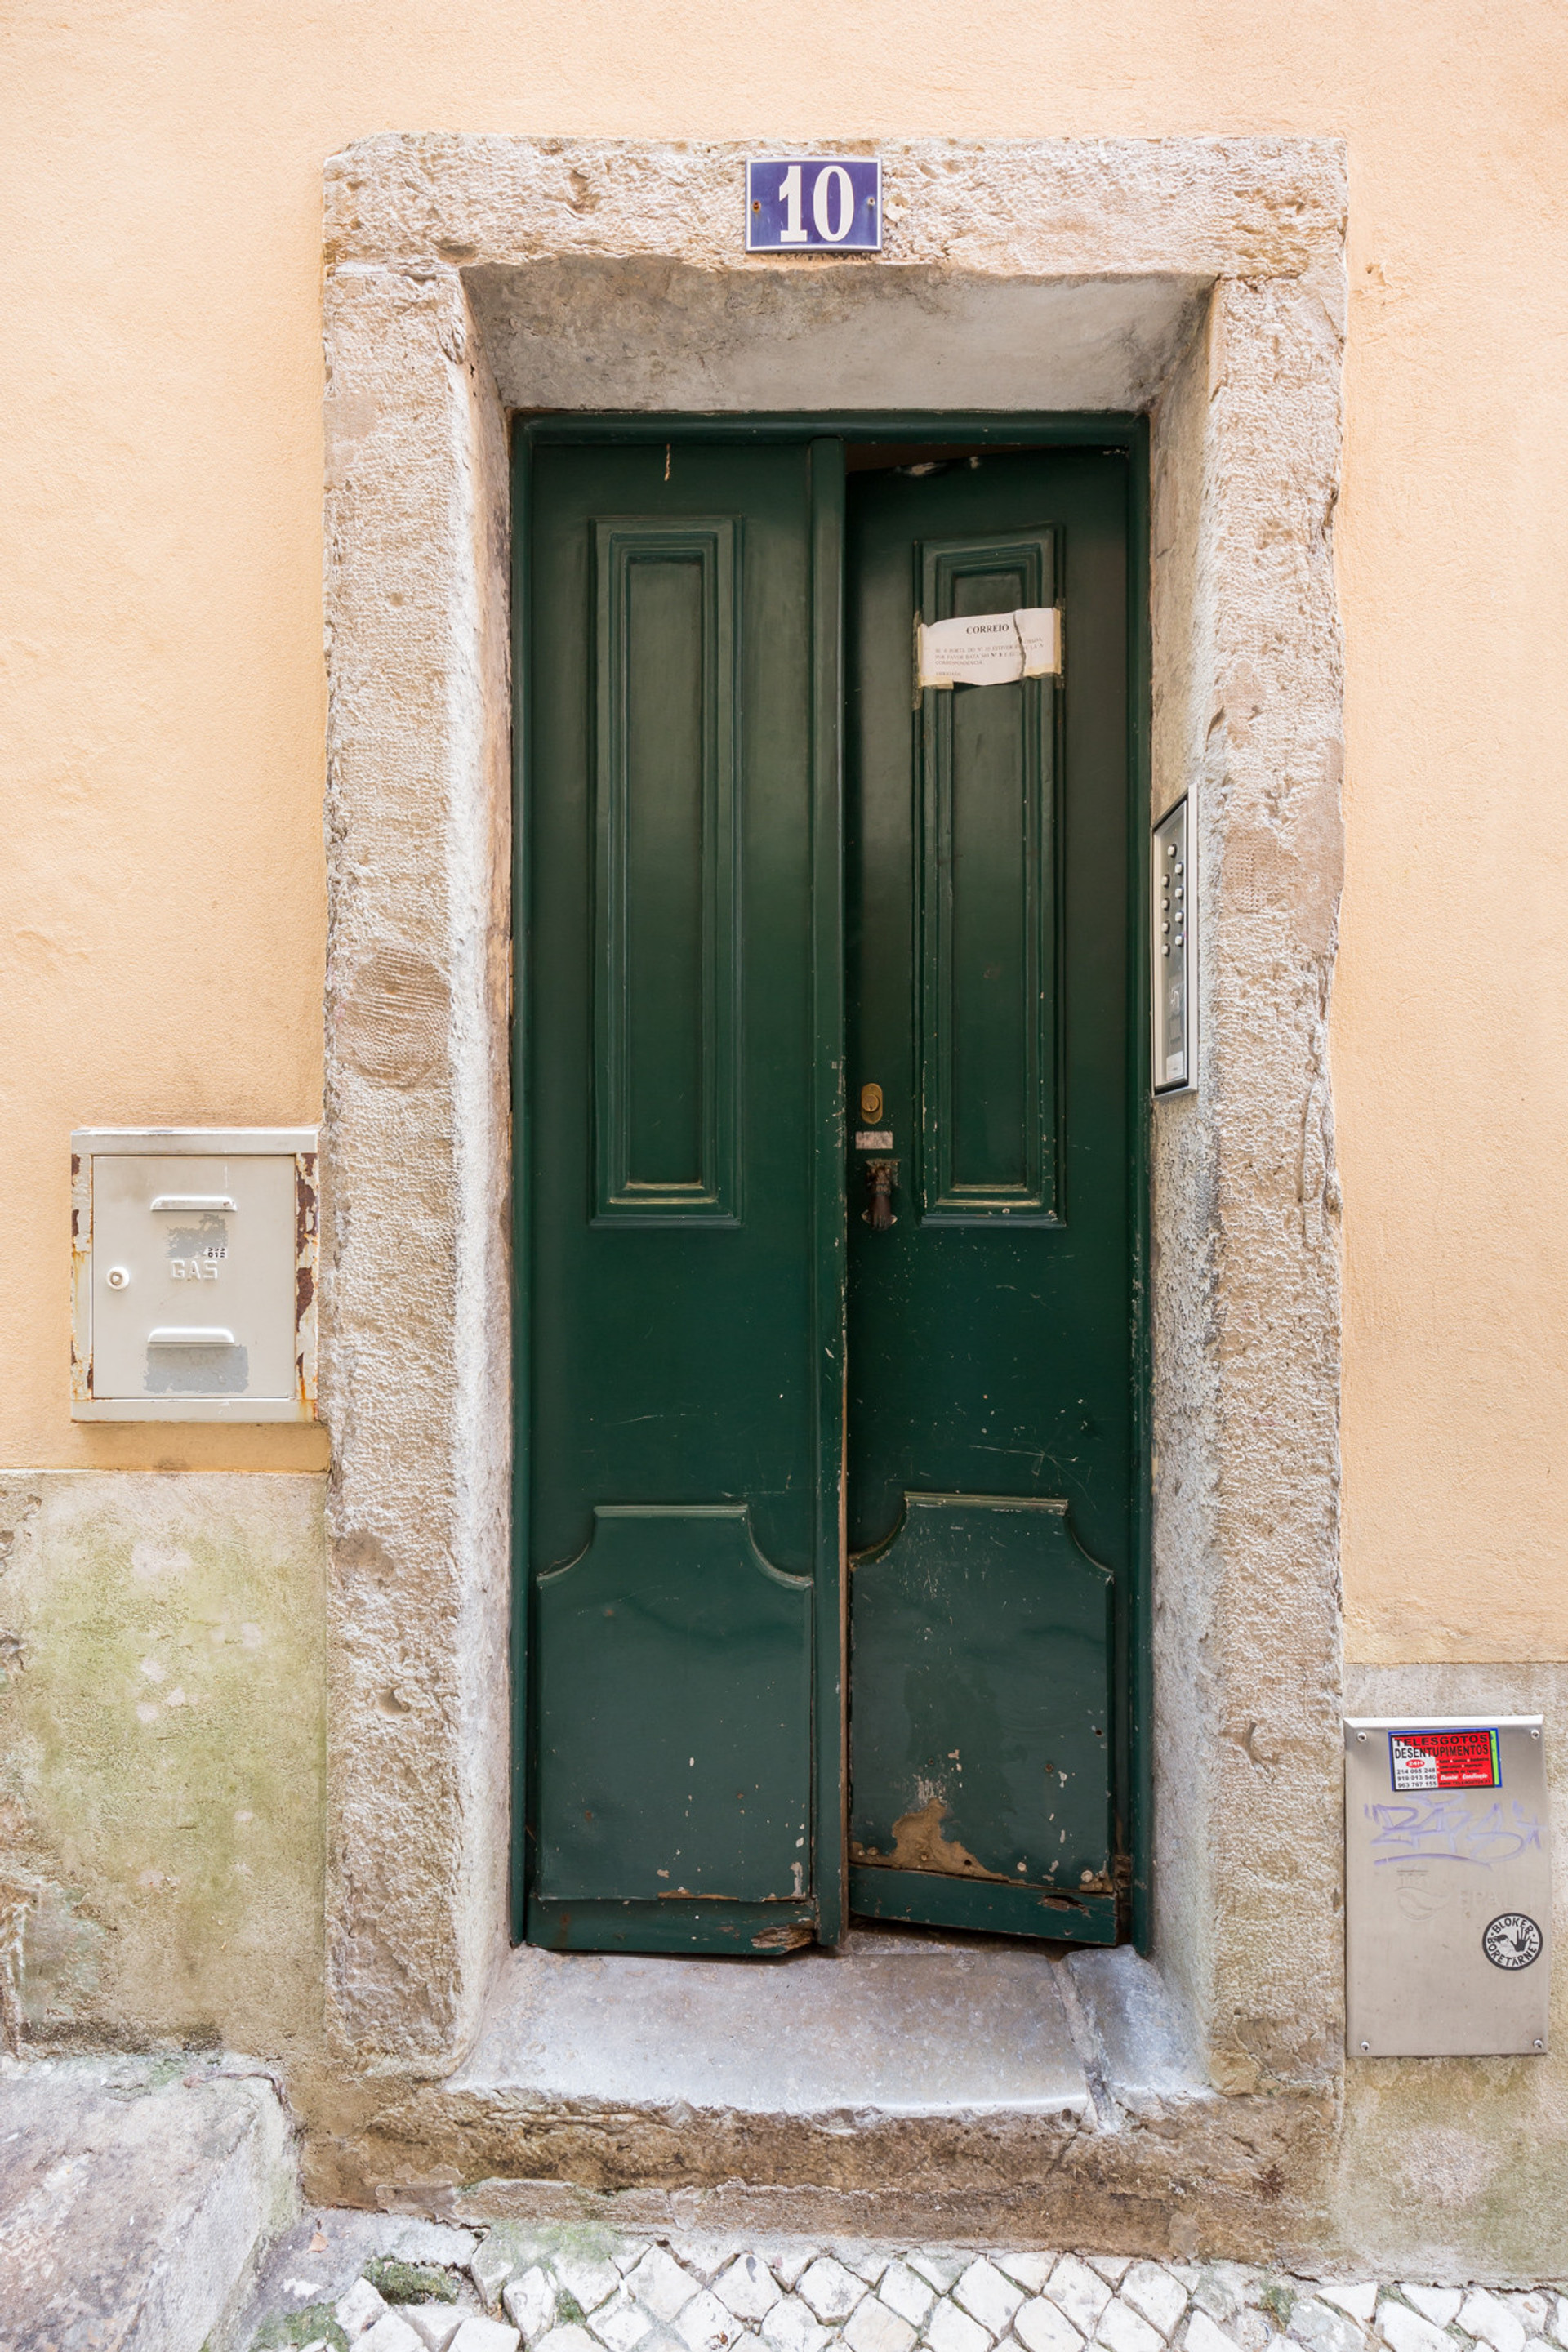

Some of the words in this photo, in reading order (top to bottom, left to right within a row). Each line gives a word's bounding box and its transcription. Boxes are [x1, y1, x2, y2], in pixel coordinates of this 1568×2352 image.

[779, 165, 855, 243] 10
[966, 624, 1009, 635] CORREIO
[172, 1260, 218, 1280] GAS
[1394, 1735, 1488, 1747] TELESGOTOS
[1394, 1744, 1489, 1759] DESENTUPIMENTOS
[1492, 1917, 1535, 1934] BLOKER
